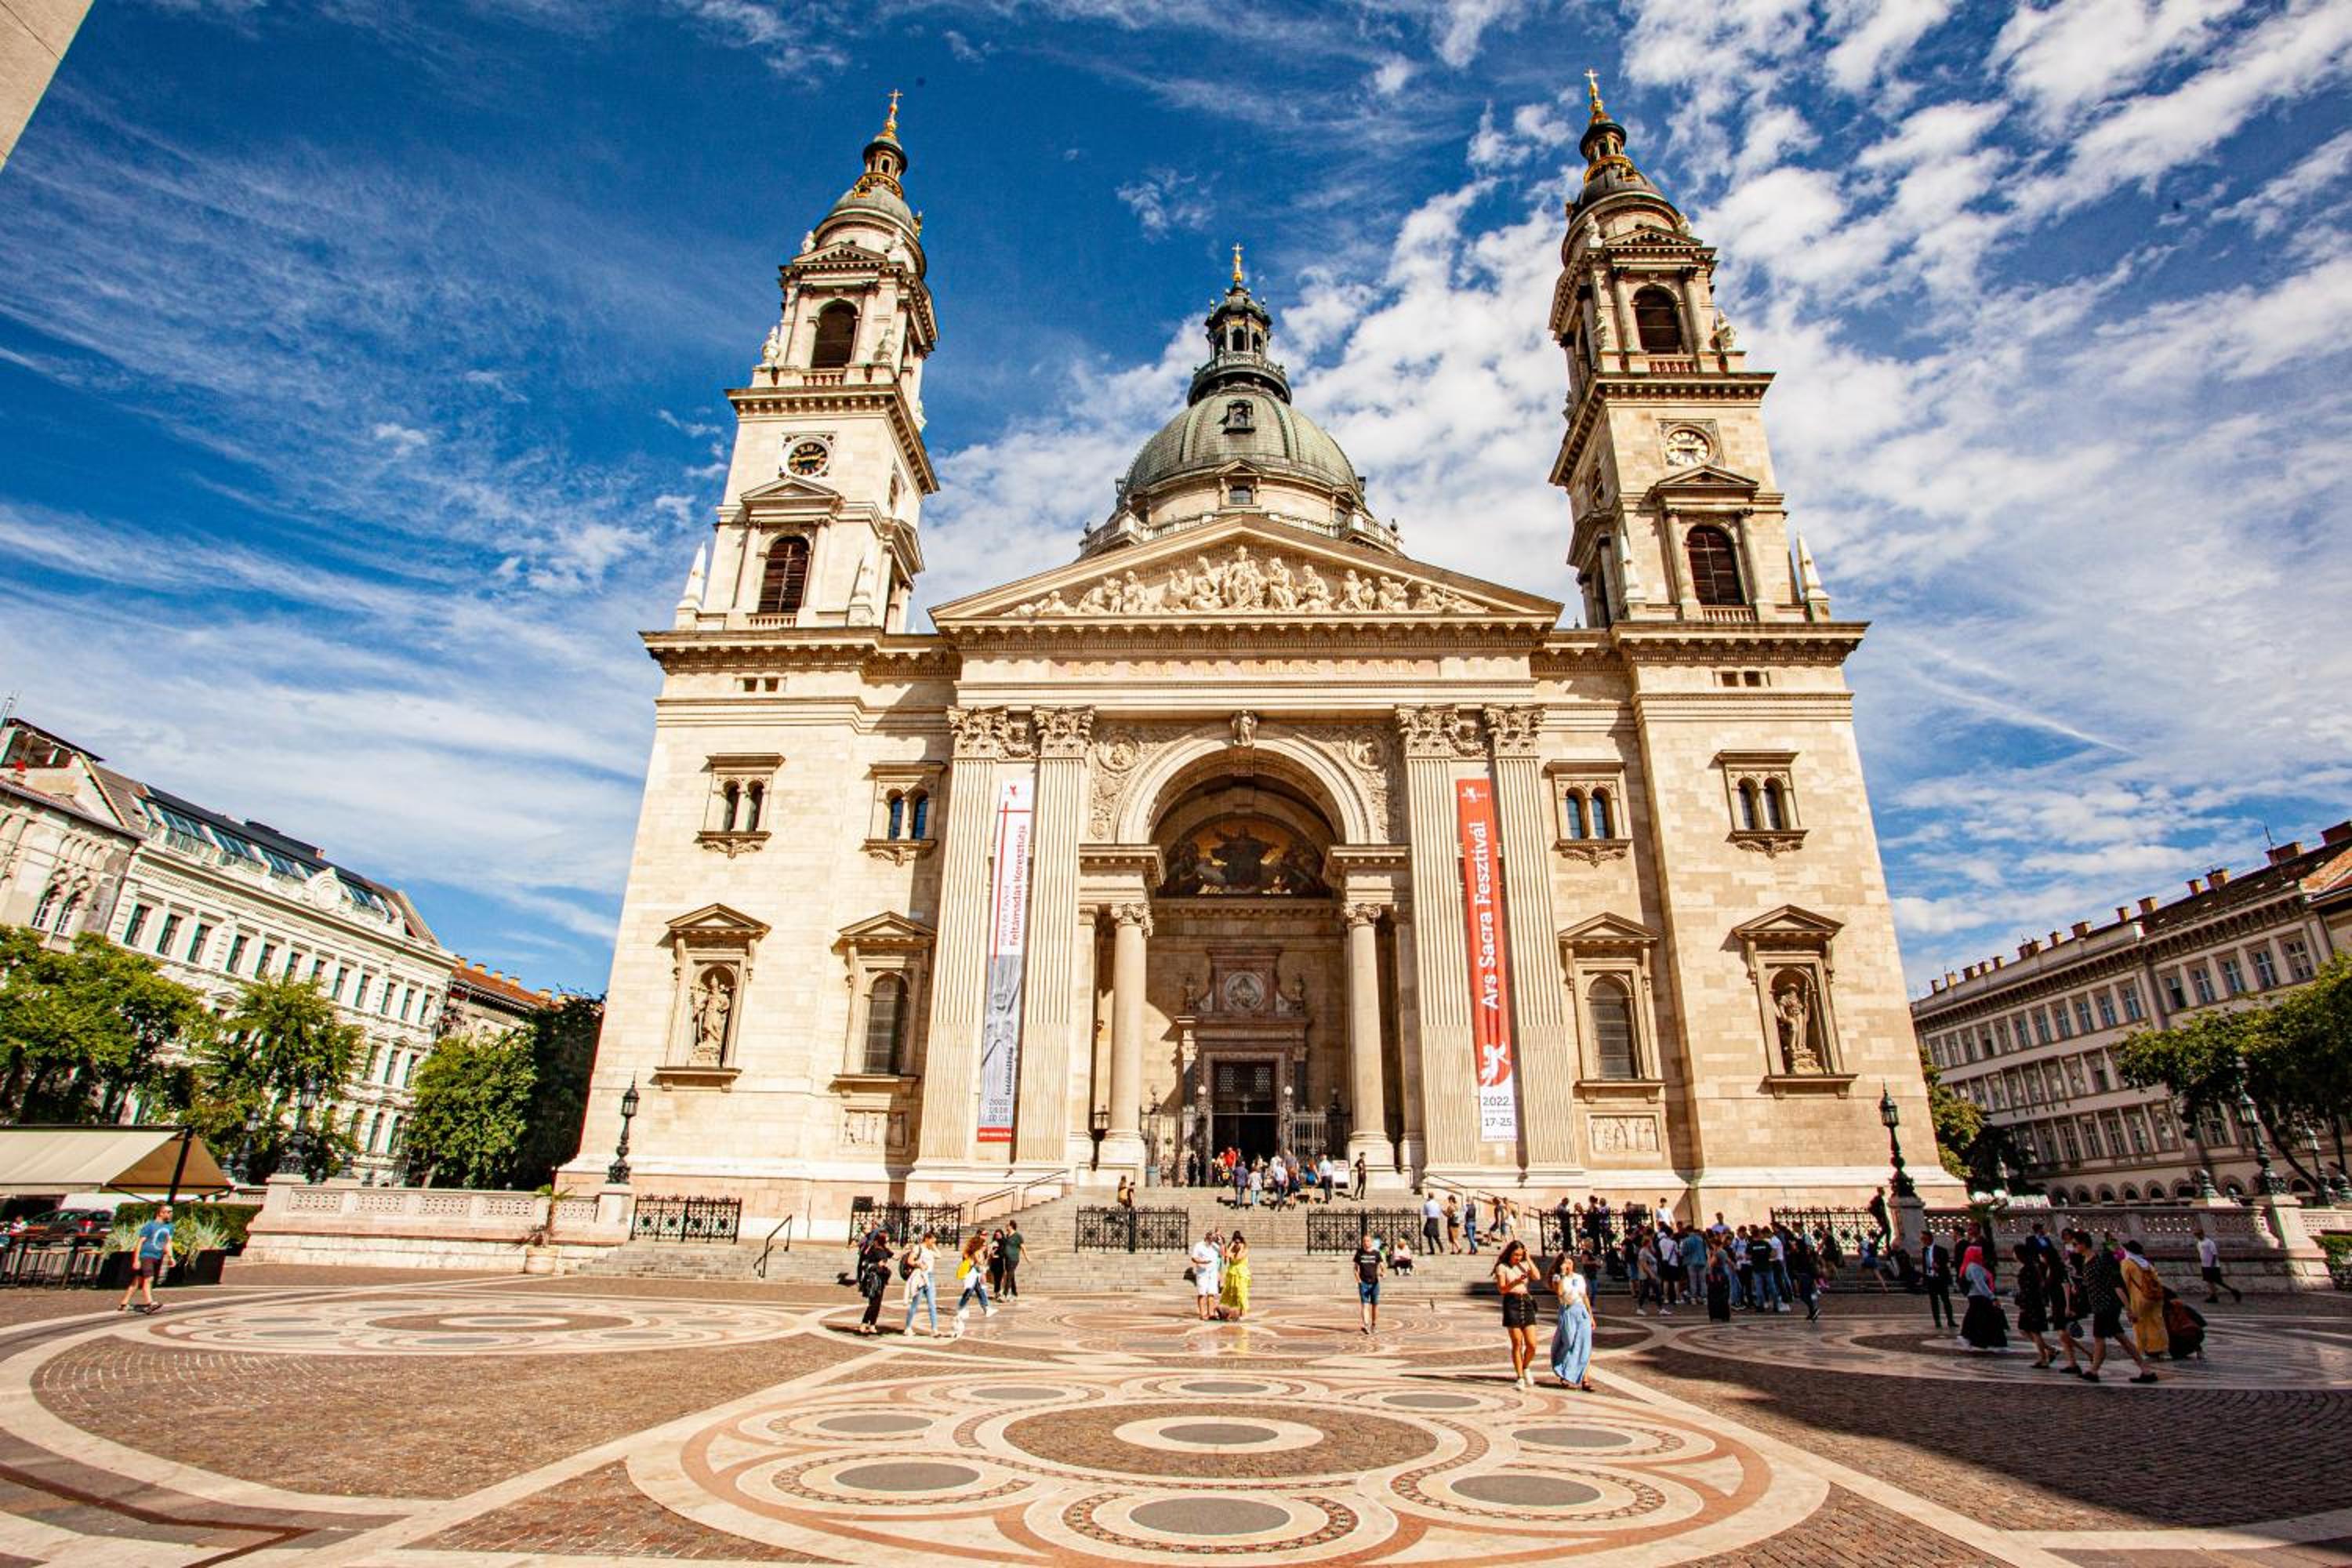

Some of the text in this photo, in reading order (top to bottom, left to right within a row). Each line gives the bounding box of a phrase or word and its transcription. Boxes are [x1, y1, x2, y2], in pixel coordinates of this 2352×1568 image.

[1470, 821, 1499, 1010] Ars Sacra Fesztivál
